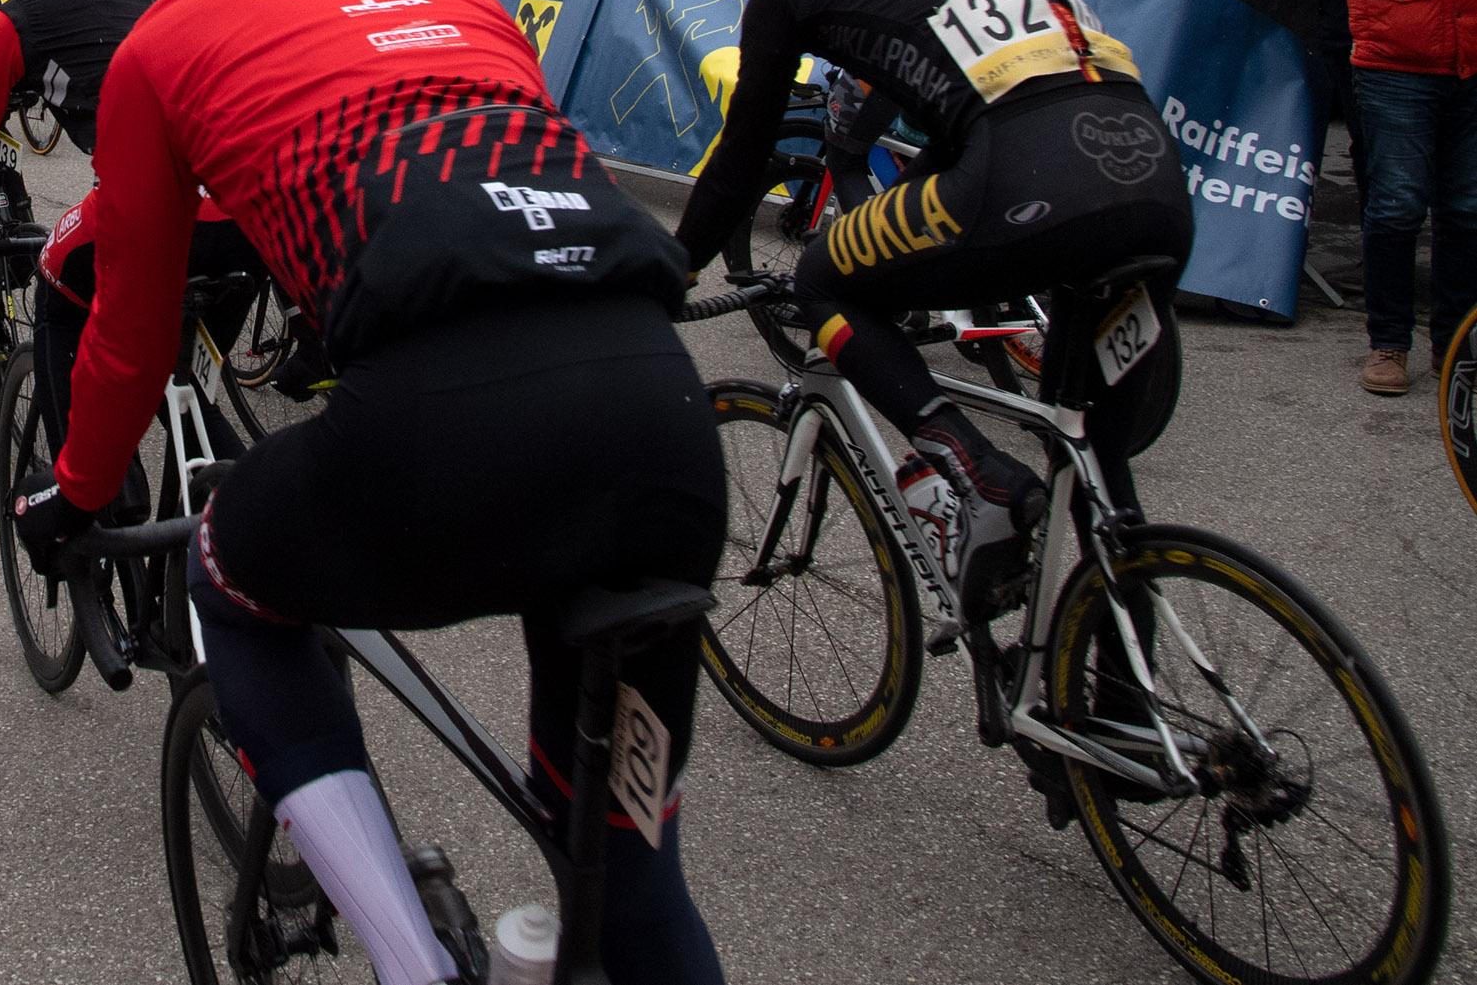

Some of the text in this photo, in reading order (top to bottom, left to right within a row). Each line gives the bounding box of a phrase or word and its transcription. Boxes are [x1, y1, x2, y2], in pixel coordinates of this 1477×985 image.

[827, 173, 964, 276] DUKLA
[1105, 313, 1147, 371] 132
[845, 441, 954, 617] AUTHOR
[625, 709, 660, 823] 109
